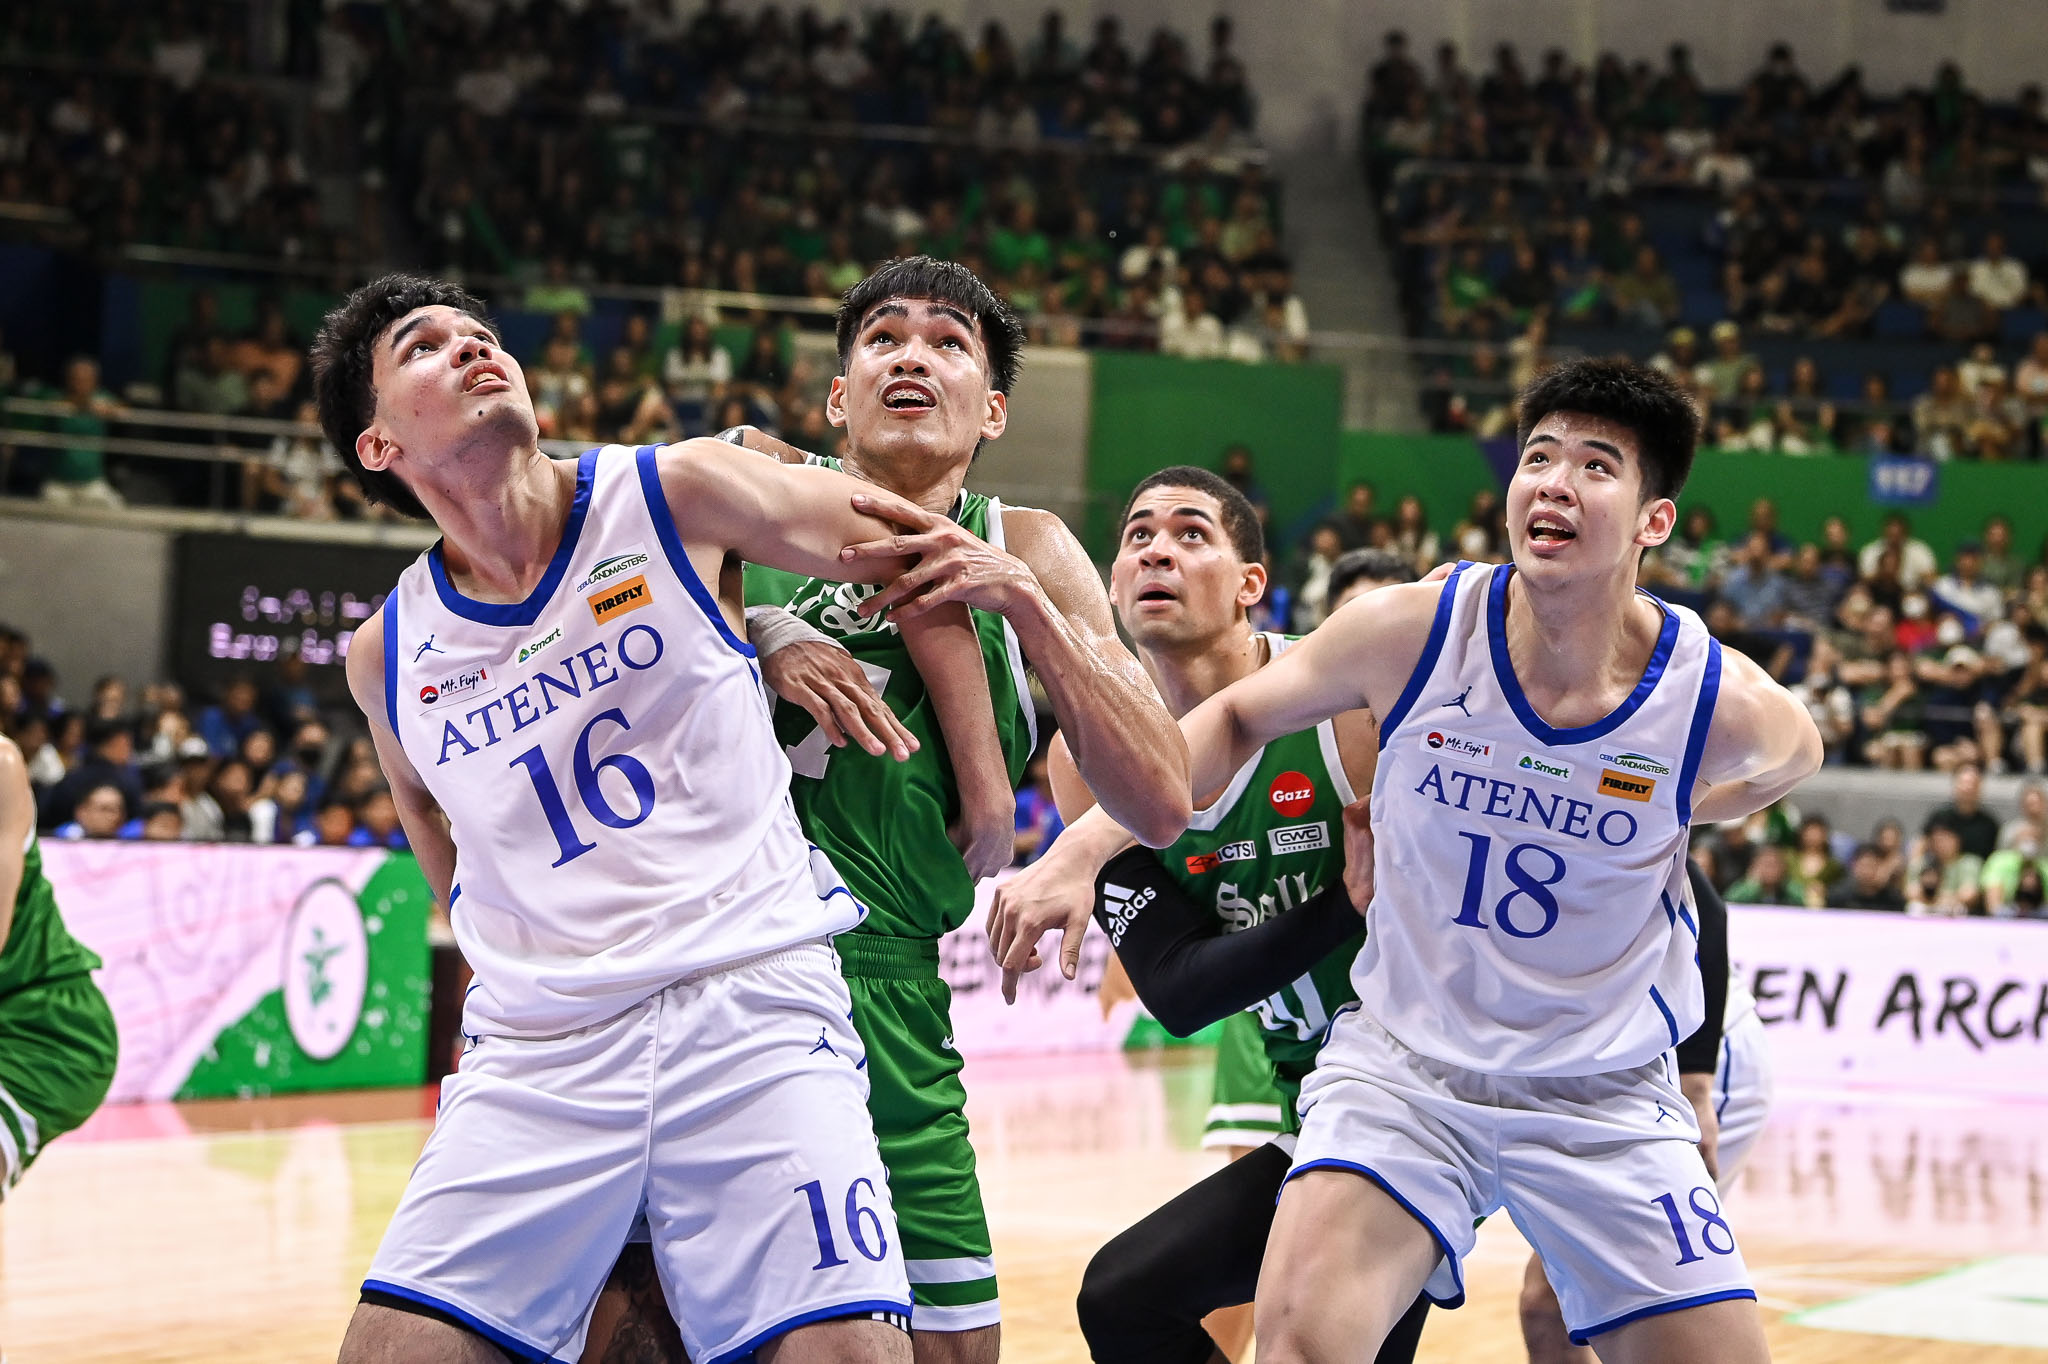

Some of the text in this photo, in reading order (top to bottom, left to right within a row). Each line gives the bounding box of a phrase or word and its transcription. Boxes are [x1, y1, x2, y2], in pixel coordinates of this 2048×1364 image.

[594, 584, 644, 615] FIREFLY
[530, 627, 562, 655] Smart
[436, 624, 664, 766] ATENEO
[440, 669, 480, 695] Mt. Fuji
[1445, 737, 1486, 758] Mt. Fuji
[1533, 760, 1570, 779] Smart
[509, 707, 656, 869] 16
[1272, 788, 1311, 803] Gazz
[1414, 763, 1638, 847] ATENEO
[1602, 776, 1651, 794] FIREFLY
[1216, 843, 1255, 861] ICTSI
[1216, 872, 1324, 935] Sall
[1451, 830, 1567, 939] 18
[1111, 886, 1157, 947] adidas
[794, 1177, 888, 1271] 16
[1650, 1186, 1735, 1267] 18
